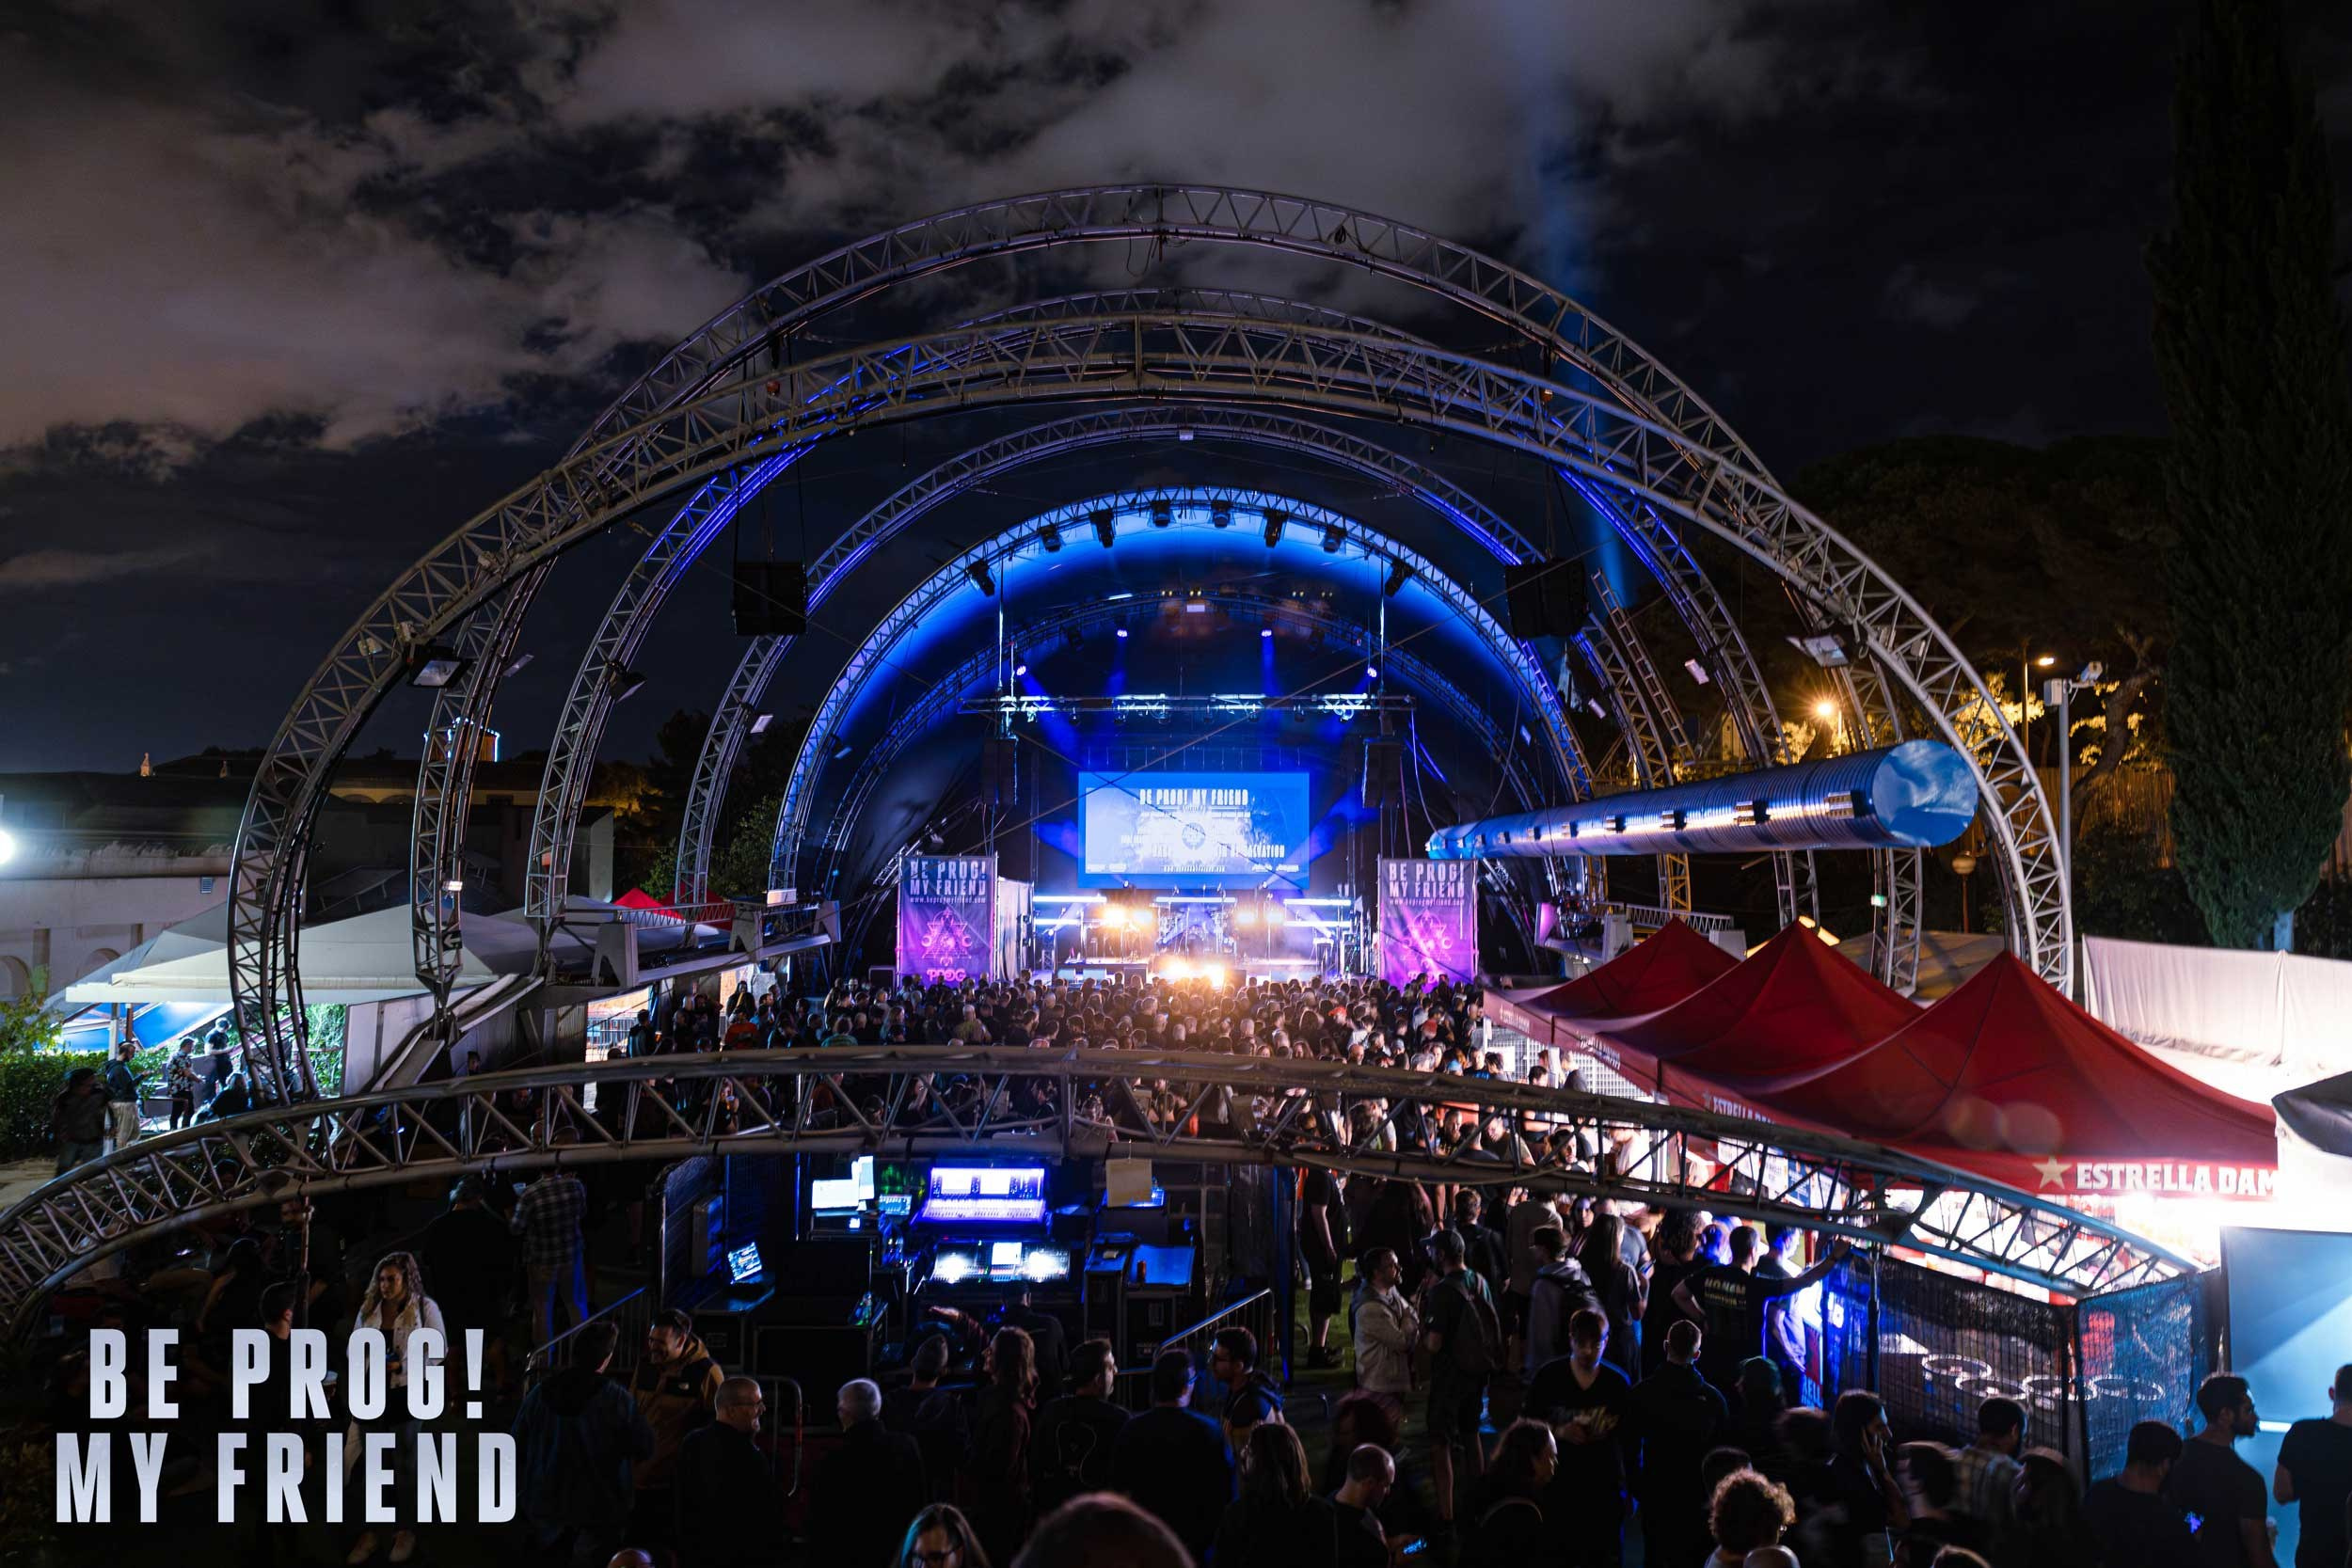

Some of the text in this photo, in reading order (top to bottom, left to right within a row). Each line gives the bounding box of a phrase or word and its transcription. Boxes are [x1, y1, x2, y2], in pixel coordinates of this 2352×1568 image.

[1139, 788, 1152, 805] BE
[1192, 788, 1207, 805] MY
[1211, 788, 1248, 806] FRIEND
[910, 861, 986, 879] BE PROG!
[1389, 863, 1464, 881] BE PROG!
[910, 879, 986, 895] MY FRIEND
[1389, 881, 1464, 897] MY FRIEND
[2076, 1162, 2214, 1193] ESTRELLA
